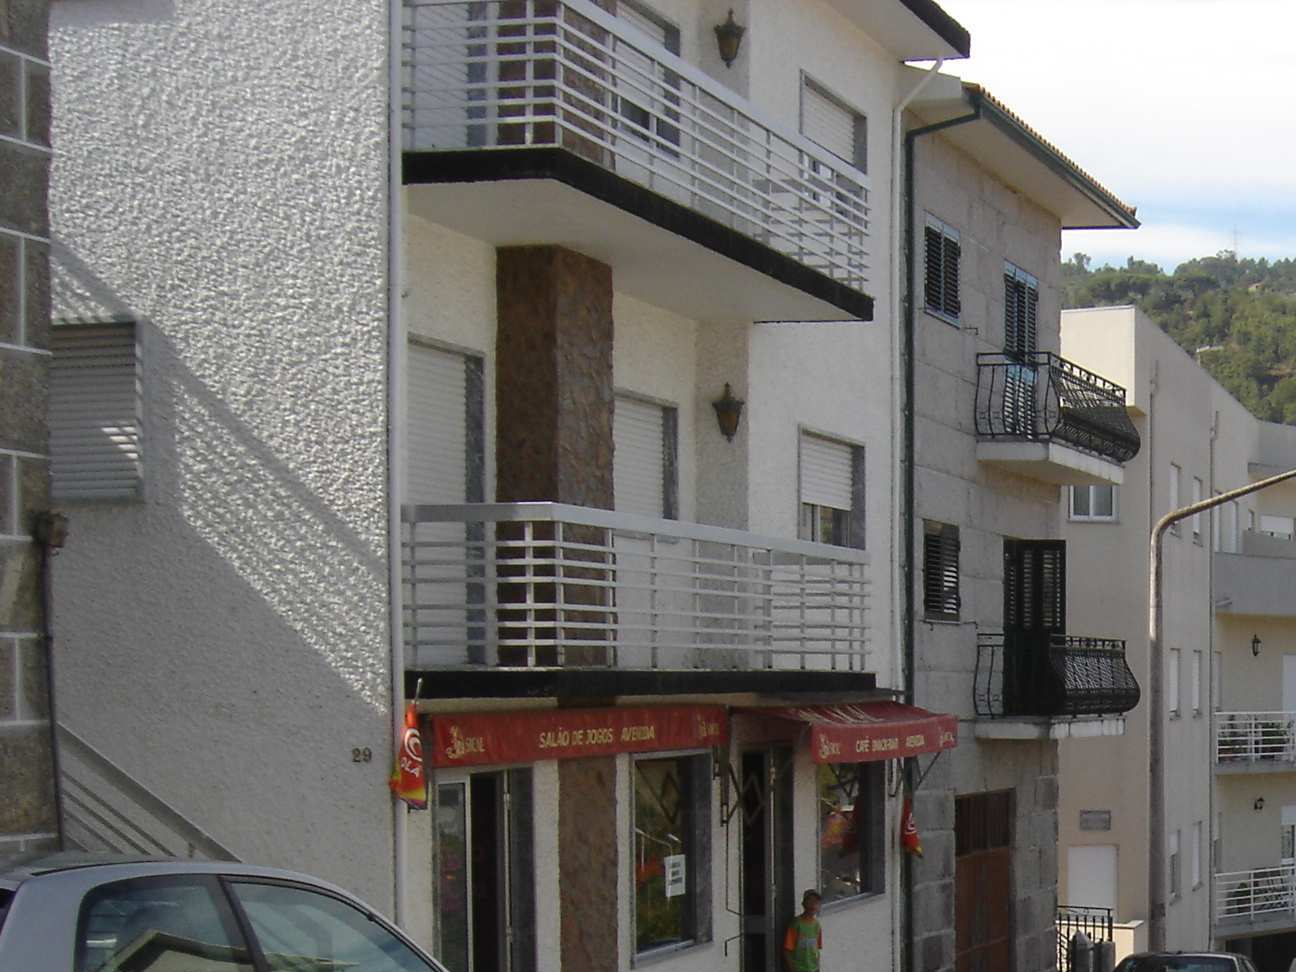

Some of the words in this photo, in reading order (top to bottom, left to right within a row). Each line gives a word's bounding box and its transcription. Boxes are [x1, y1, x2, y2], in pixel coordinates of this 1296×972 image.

[538, 727, 570, 748] SALÃO
[572, 729, 584, 746] DE
[585, 727, 614, 745] JOGOS
[352, 747, 372, 763] 29
